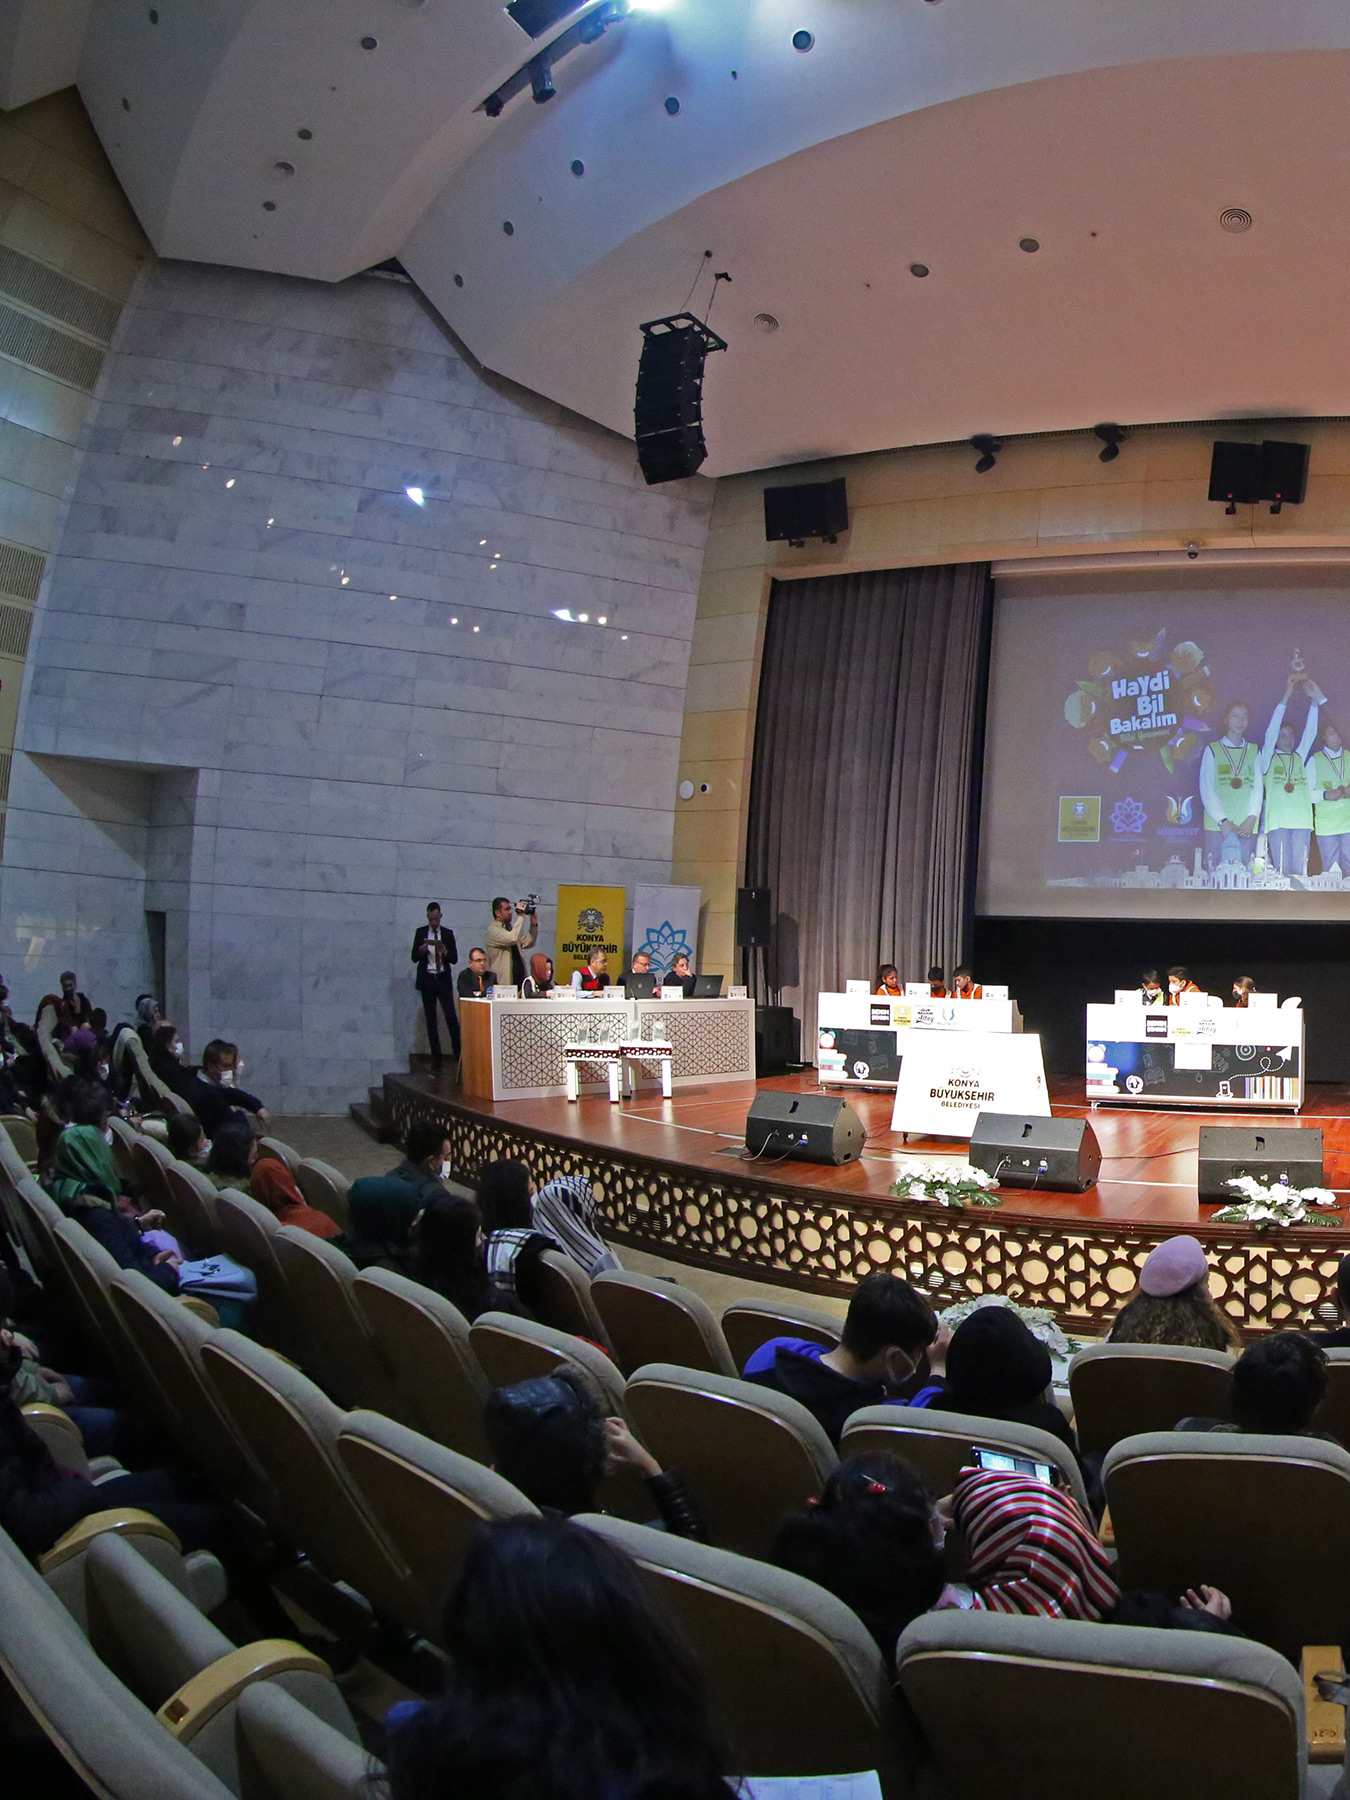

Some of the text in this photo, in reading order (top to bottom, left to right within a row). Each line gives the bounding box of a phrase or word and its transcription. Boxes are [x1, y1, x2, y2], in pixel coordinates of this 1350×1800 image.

[1111, 670, 1170, 699] Haydi
[1136, 693, 1165, 716] Bil
[576, 934, 605, 942] KONYA
[947, 1078, 980, 1088] KONYA
